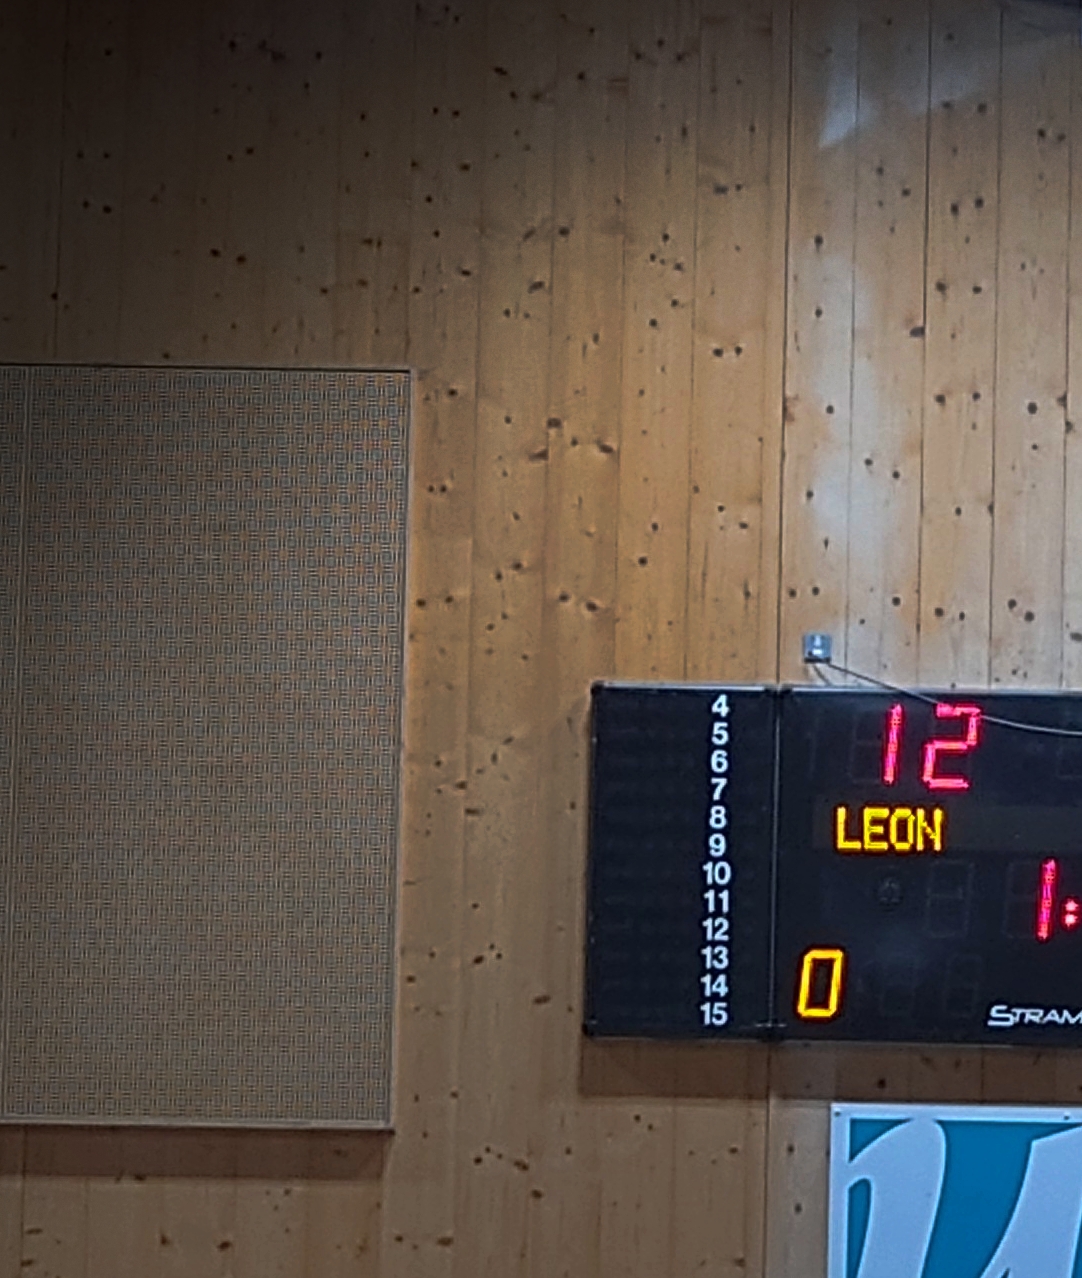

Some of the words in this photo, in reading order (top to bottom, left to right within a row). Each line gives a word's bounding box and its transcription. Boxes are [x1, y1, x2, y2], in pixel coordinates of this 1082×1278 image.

[711, 693, 730, 718] 4
[711, 721, 729, 746] 5
[883, 703, 983, 790] 12
[710, 749, 729, 774] 6
[710, 777, 728, 801] 7
[708, 804, 728, 830] 8
[836, 807, 944, 853] LEON
[708, 832, 727, 858] 9
[702, 860, 732, 886] 10
[703, 889, 730, 914] 11
[702, 916, 730, 942] 12
[701, 945, 729, 970] 13
[700, 973, 729, 998] 14
[798, 949, 845, 1019] 0
[700, 1001, 728, 1026] 15
